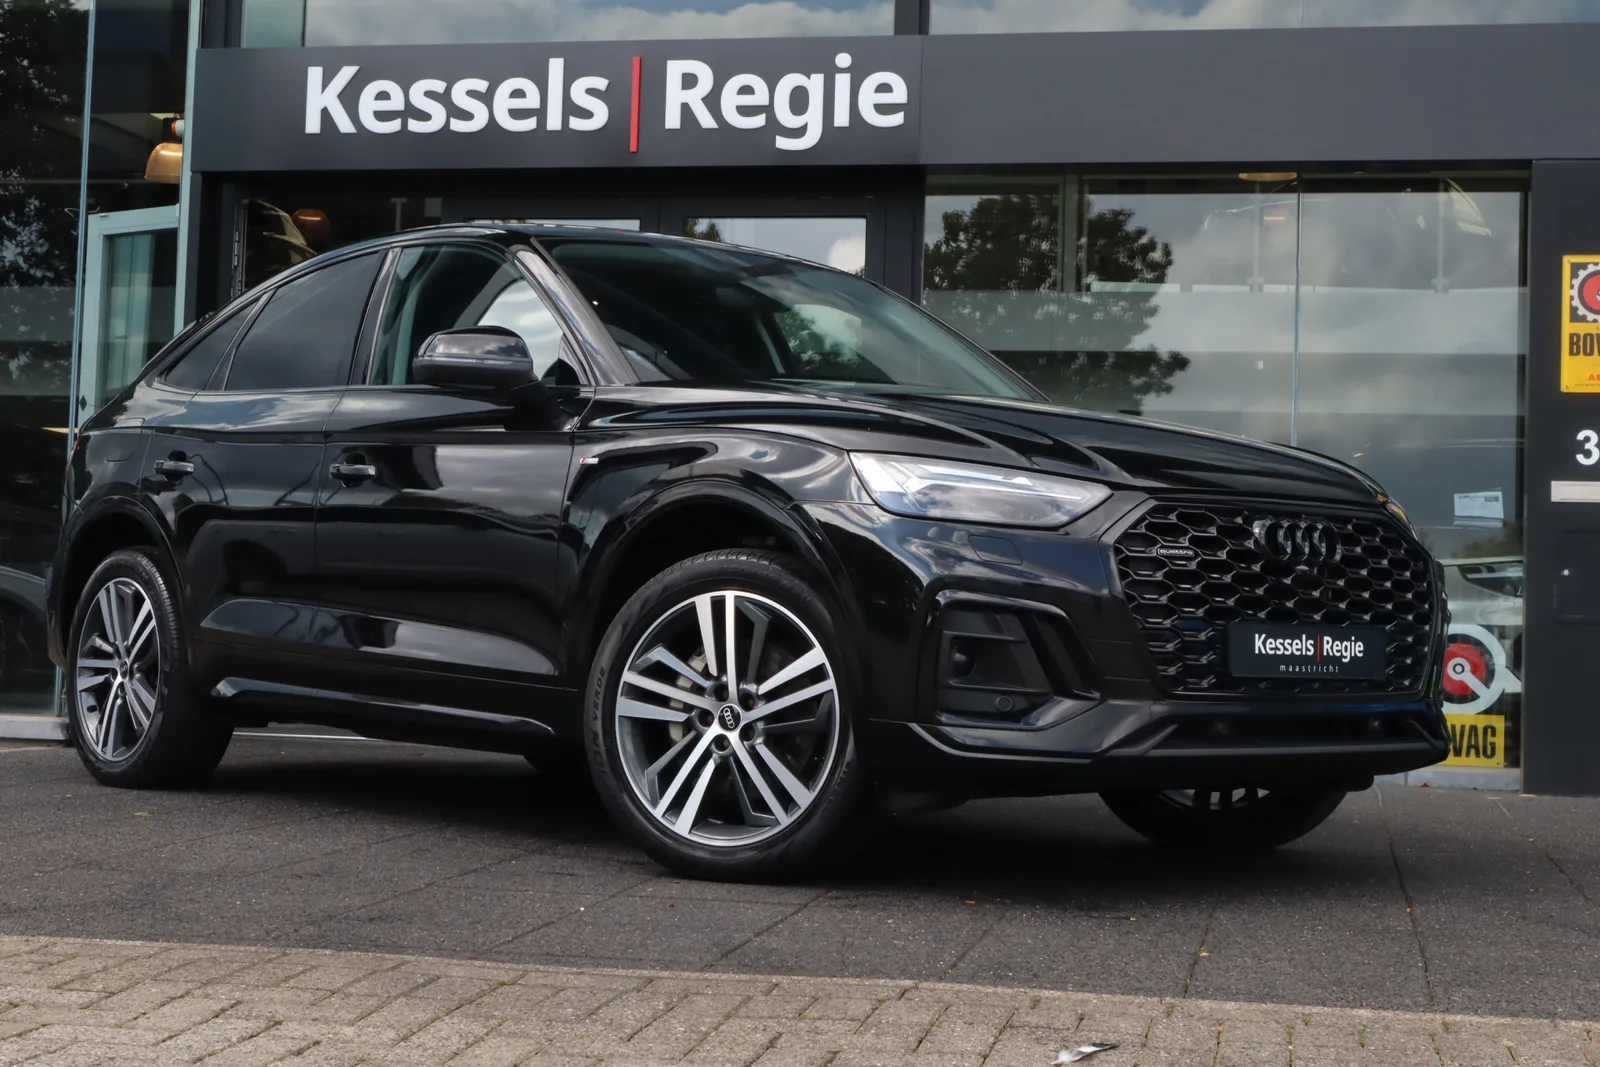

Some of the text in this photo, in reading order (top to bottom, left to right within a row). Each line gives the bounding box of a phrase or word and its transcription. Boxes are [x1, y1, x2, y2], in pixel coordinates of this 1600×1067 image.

[304, 52, 908, 151] Kessels Regie
[1576, 429, 1600, 465] 3
[1254, 633, 1364, 662] Kessels Regie
[1280, 664, 1339, 673] maastricht
[1450, 723, 1497, 759] VAG
